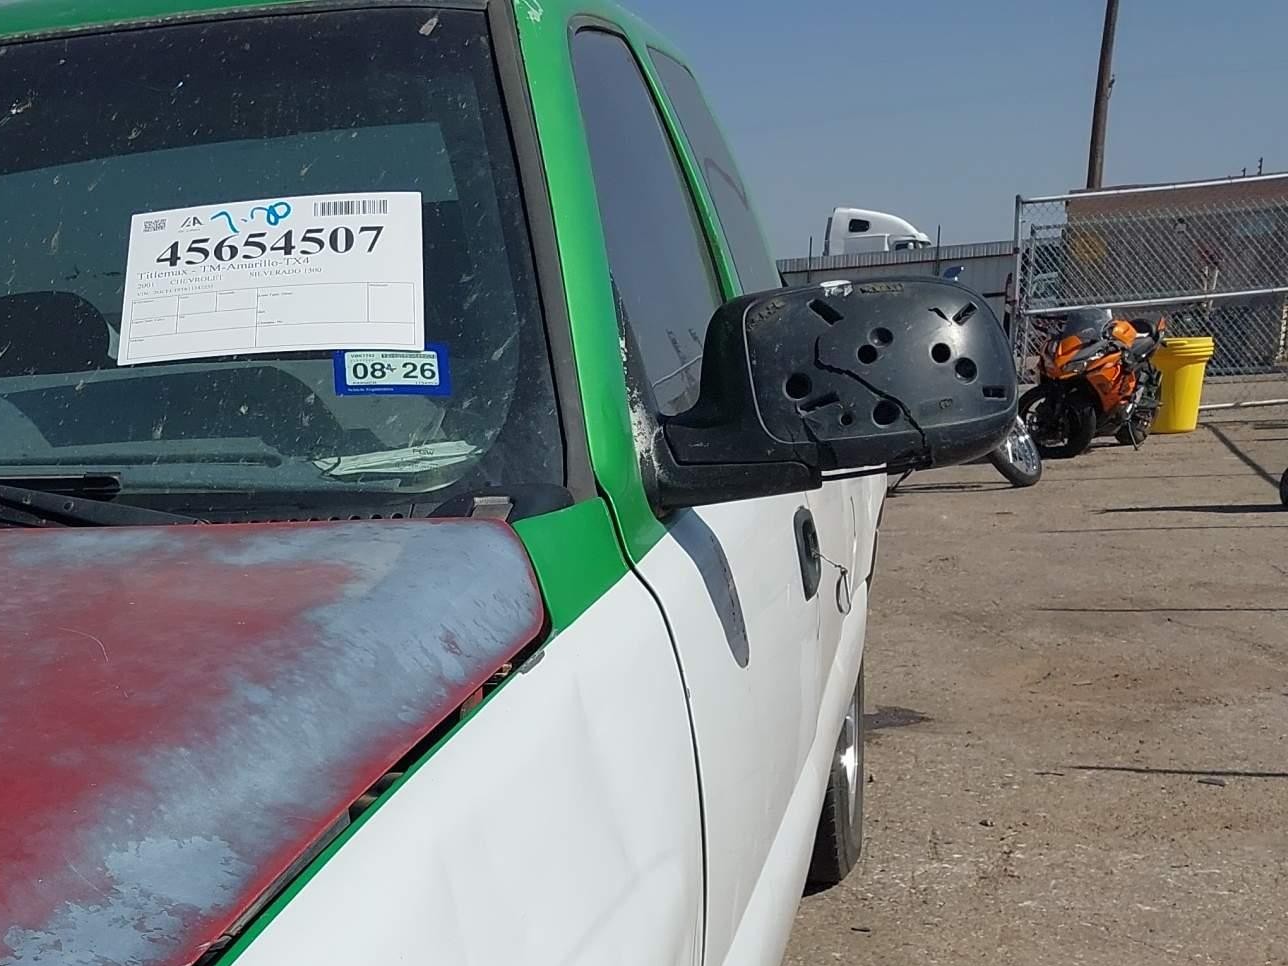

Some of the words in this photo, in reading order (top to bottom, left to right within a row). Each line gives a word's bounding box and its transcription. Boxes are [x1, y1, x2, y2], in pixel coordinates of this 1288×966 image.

[156, 226, 384, 267] 45654507
[137, 269, 187, 281] Titlemax
[352, 362, 387, 380] 08
[402, 362, 437, 380] 26
